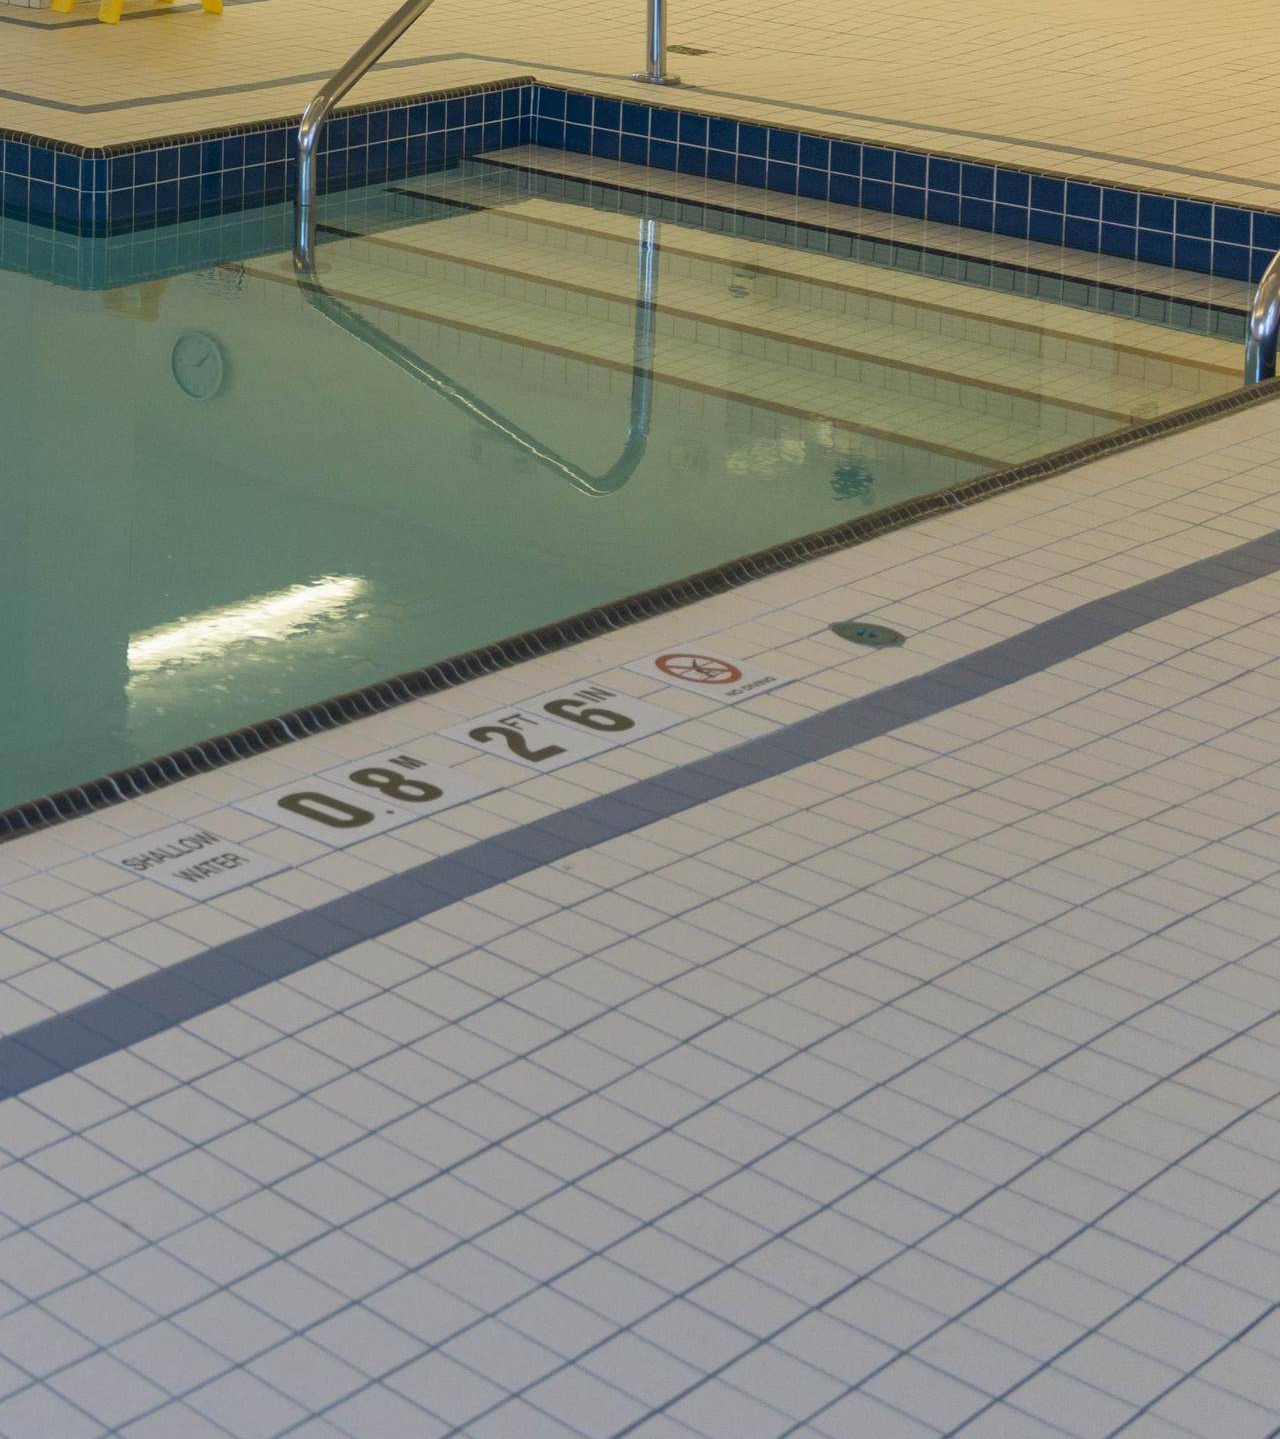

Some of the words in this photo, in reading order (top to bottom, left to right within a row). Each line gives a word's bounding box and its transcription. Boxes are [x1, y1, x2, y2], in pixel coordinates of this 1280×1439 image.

[572, 687, 619, 704] IN
[497, 713, 540, 732] FT
[543, 698, 636, 733] 6
[468, 725, 569, 763] 2
[388, 754, 428, 770] M
[121, 830, 220, 872] SHALLOW
[171, 852, 251, 883] WATER
